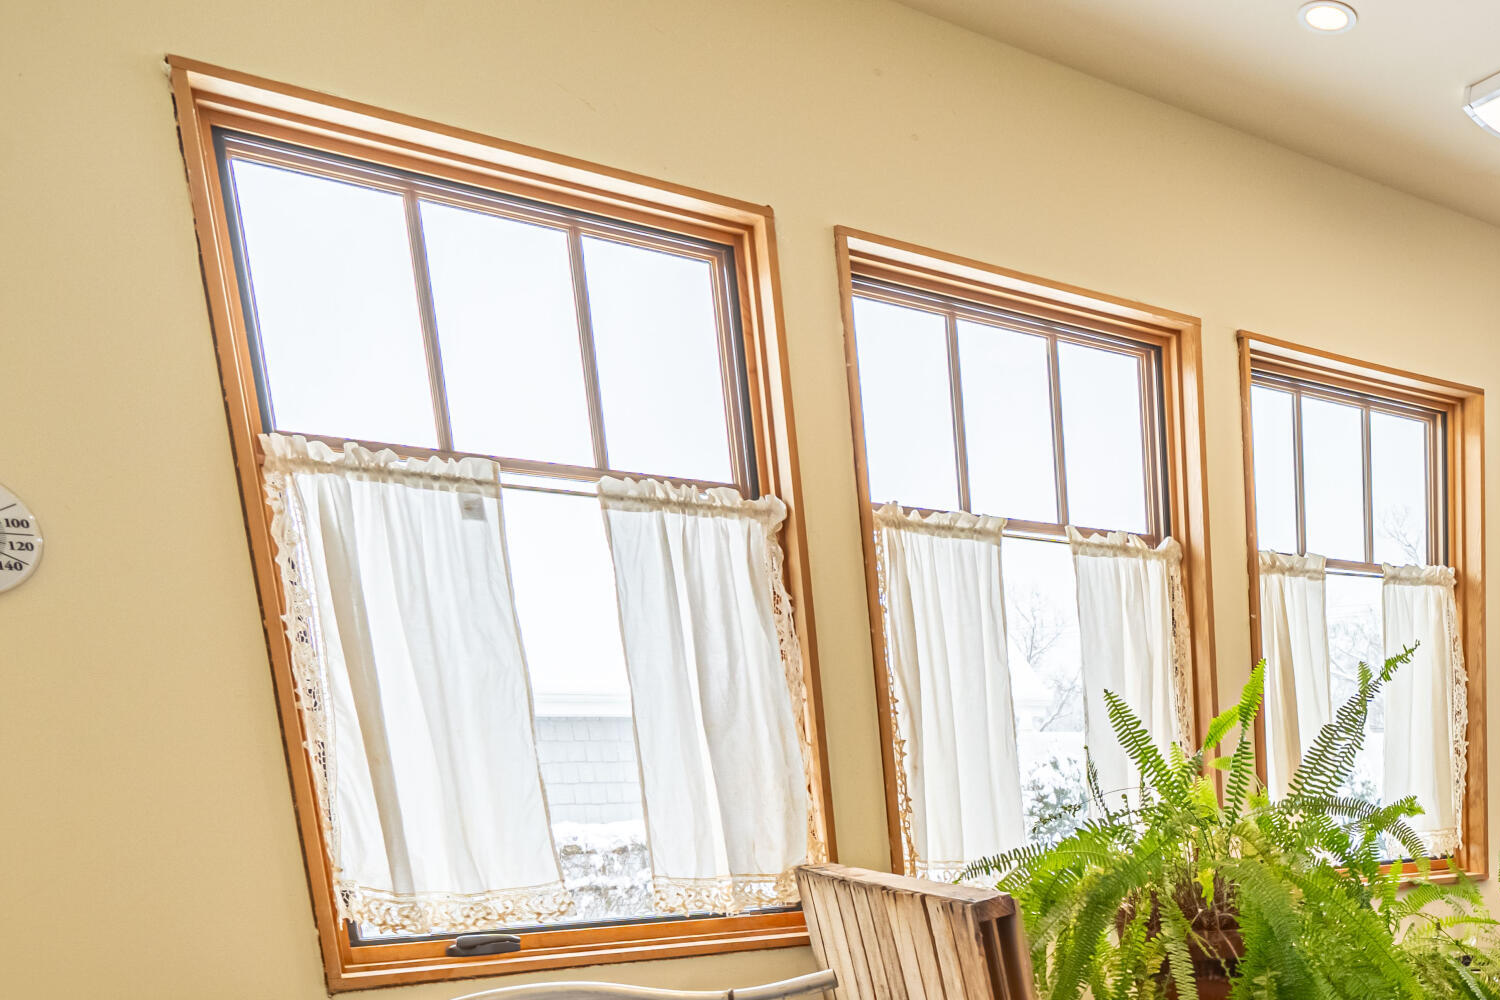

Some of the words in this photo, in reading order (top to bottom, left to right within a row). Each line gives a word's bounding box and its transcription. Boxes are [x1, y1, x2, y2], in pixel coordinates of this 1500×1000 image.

[4, 518, 30, 529] 100
[8, 541, 34, 551] 120
[0, 561, 23, 571] 140
